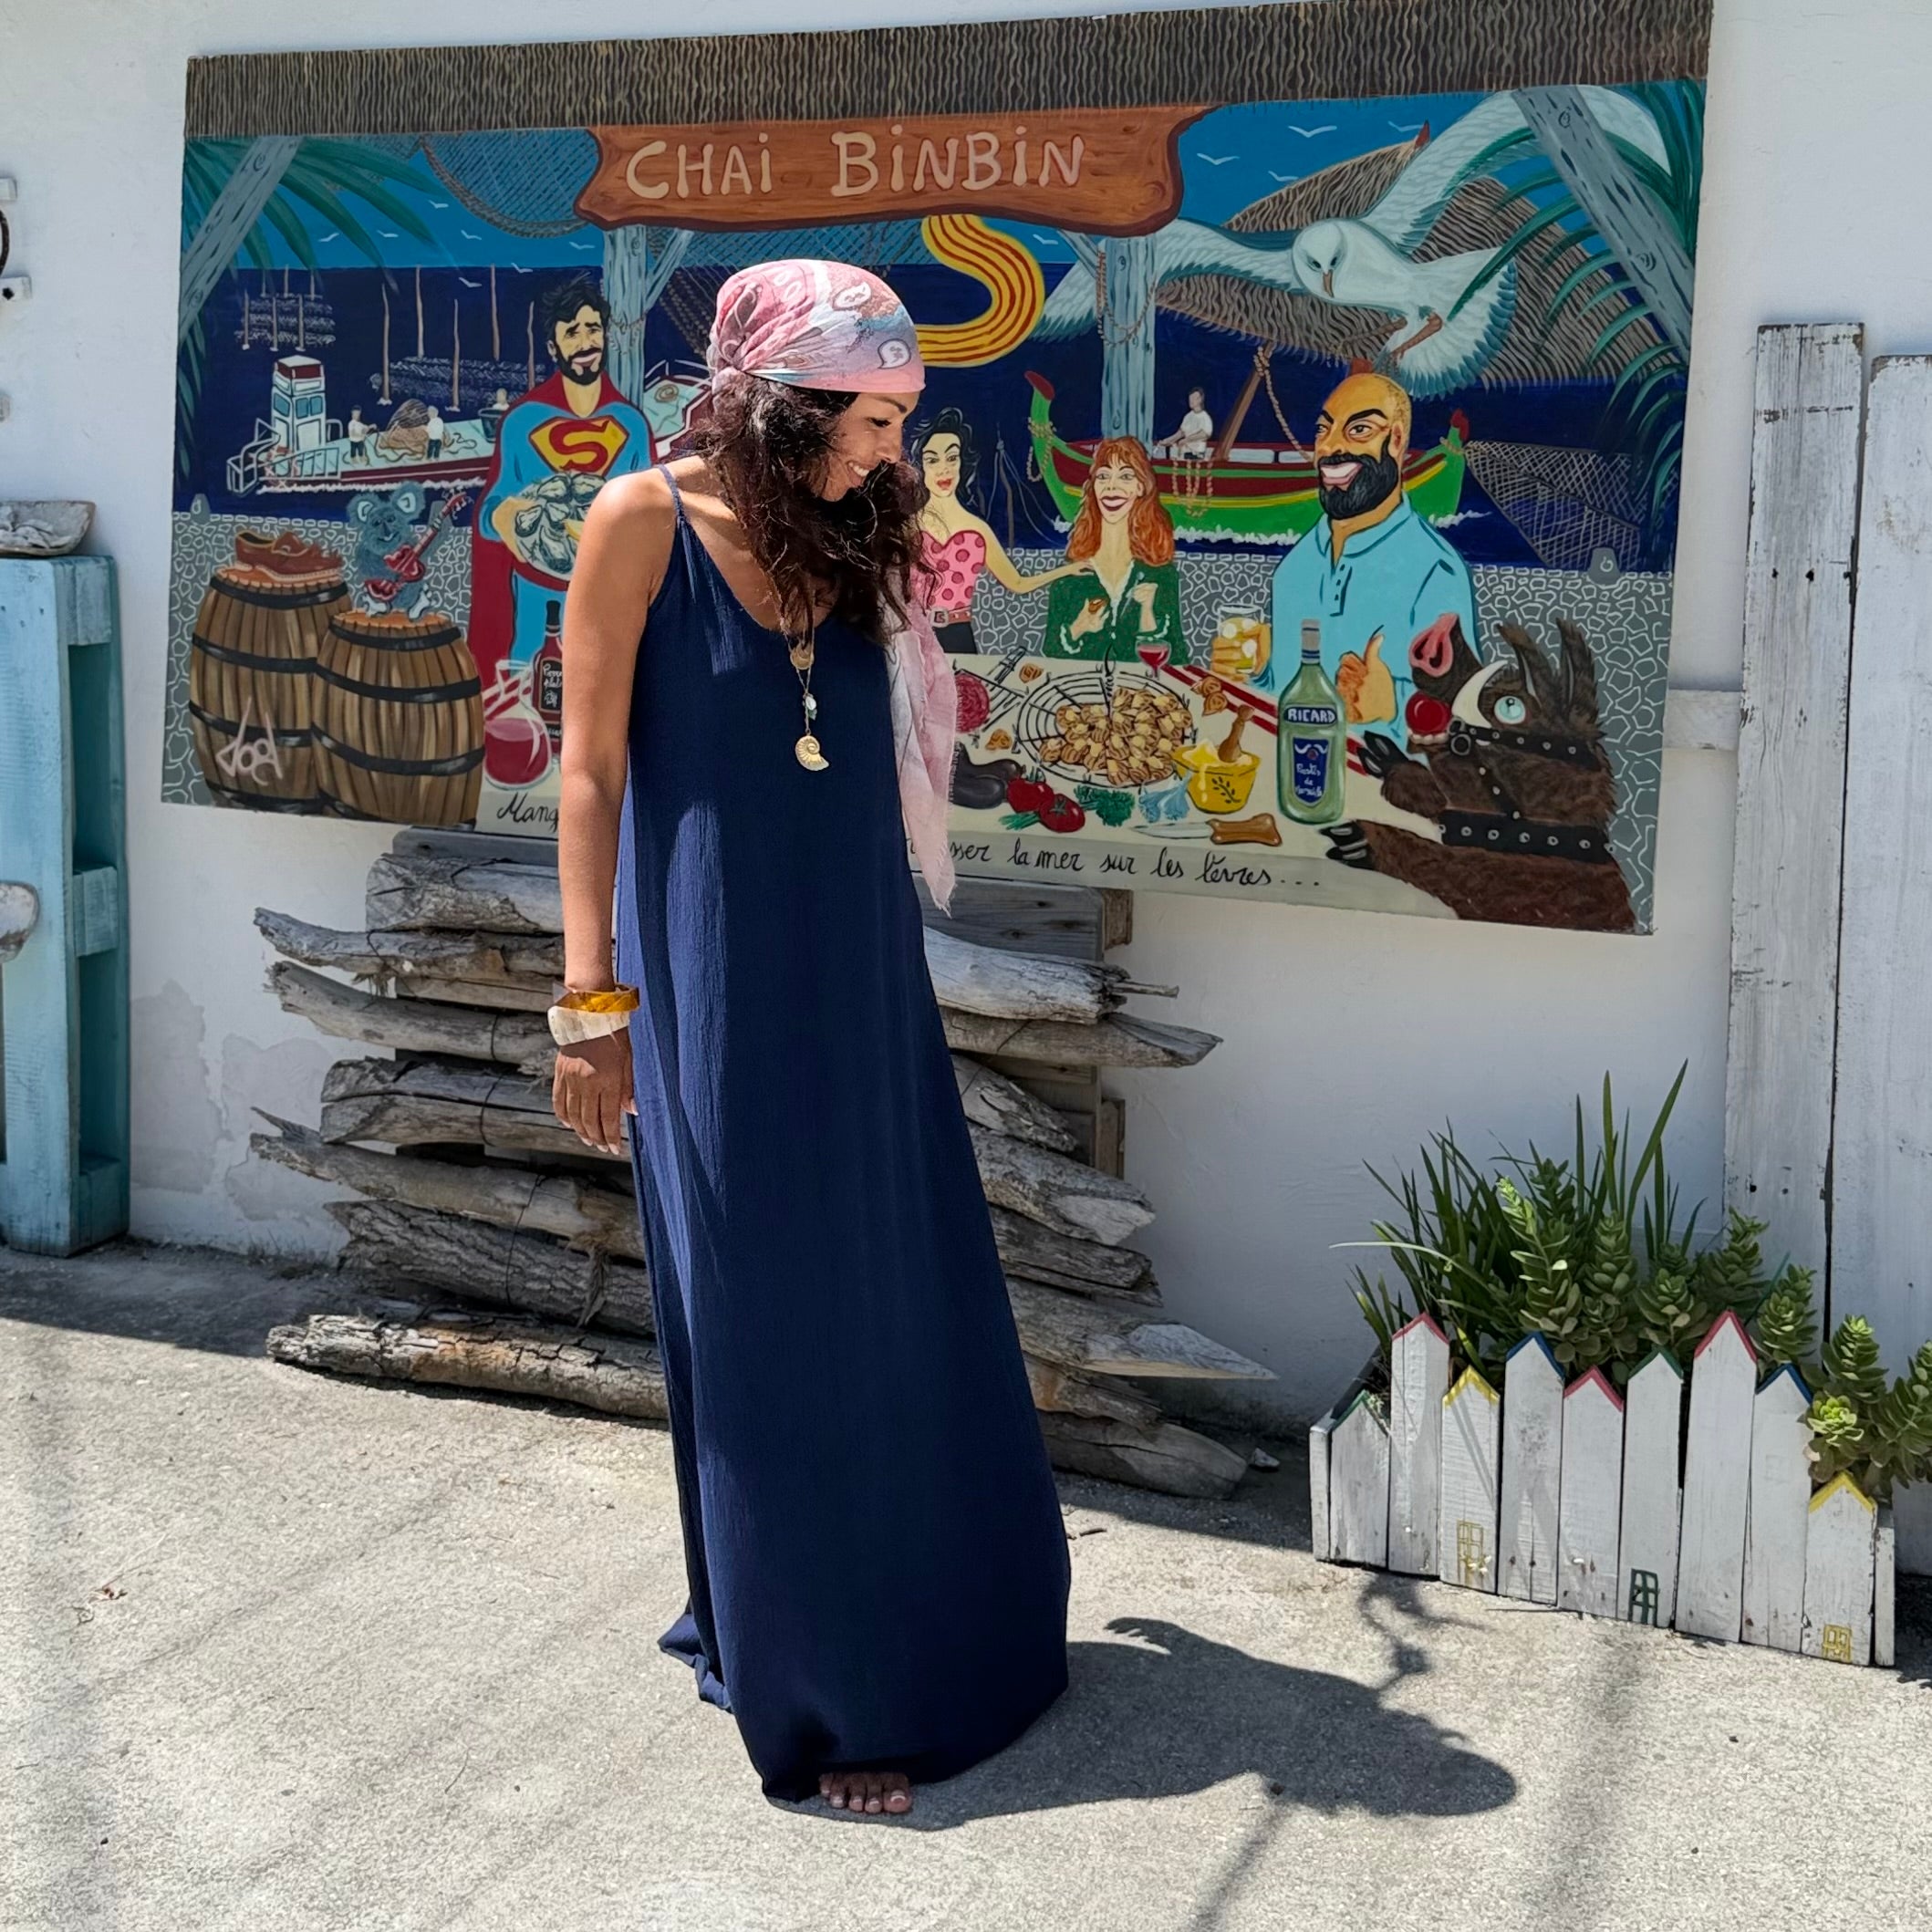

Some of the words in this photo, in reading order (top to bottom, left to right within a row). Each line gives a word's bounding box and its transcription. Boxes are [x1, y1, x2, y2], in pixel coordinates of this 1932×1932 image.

[1288, 708, 1335, 723] RICARD
[496, 792, 559, 834] Mang
[1007, 837, 1031, 866] la
[1034, 849, 1085, 872] mer
[1100, 854, 1140, 875] sur
[1149, 847, 1185, 878] les
